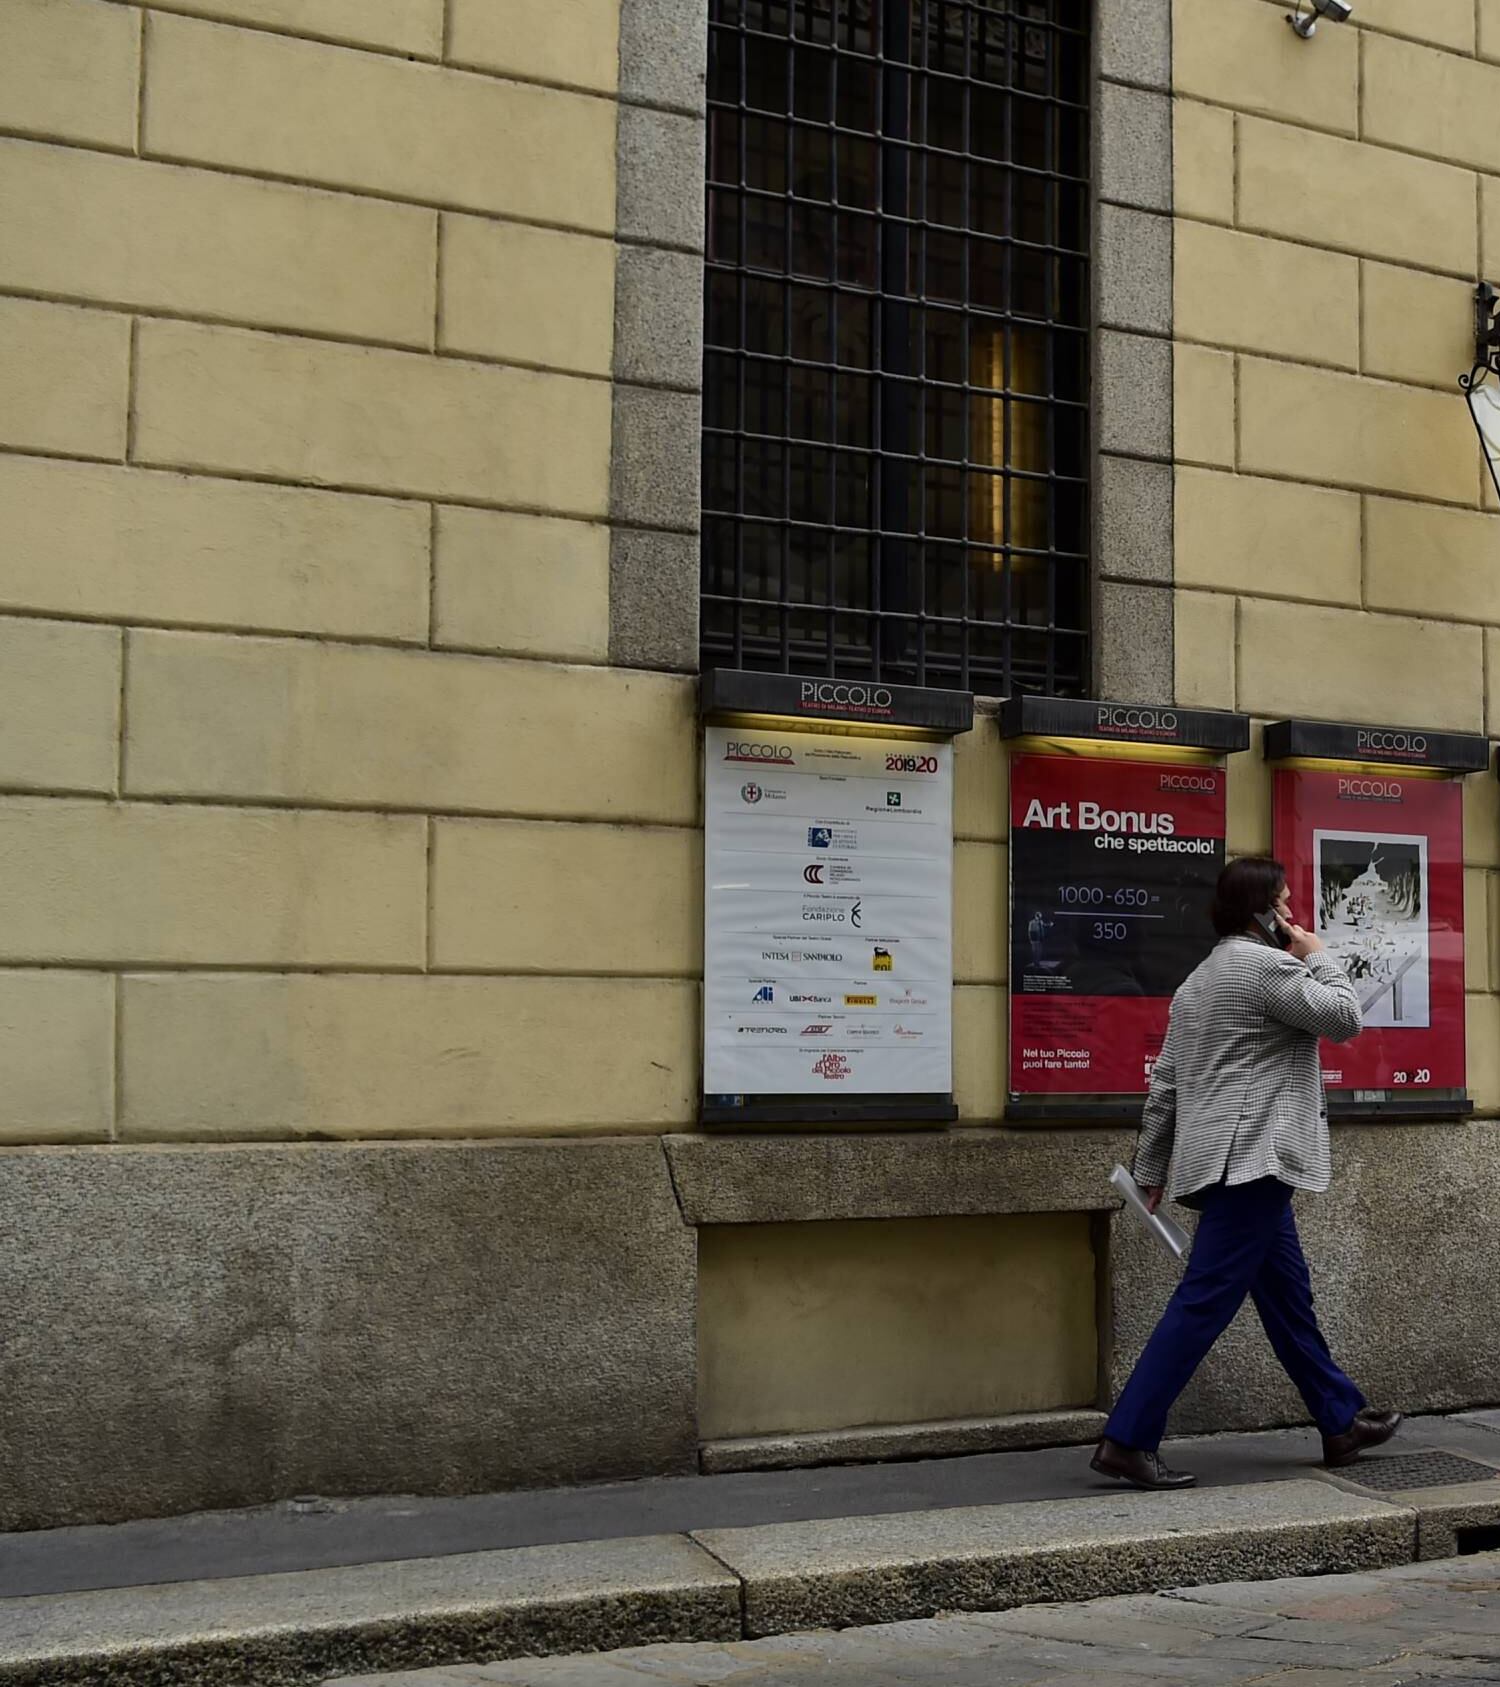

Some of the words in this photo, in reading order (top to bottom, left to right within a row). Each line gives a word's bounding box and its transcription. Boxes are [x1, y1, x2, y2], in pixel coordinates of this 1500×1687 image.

[801, 682, 892, 707] PICCOLO
[1098, 707, 1178, 730] PICCOLO
[1357, 730, 1427, 752] PICCOLO
[726, 742, 793, 759] PICCOLO
[1160, 774, 1216, 790] PICCOLO
[1338, 779, 1402, 798] PICCOLO
[1022, 799, 1070, 830] Art
[1078, 801, 1175, 835] Bonus
[1094, 833, 1125, 850] che
[1128, 836, 1215, 854] spettacolo!
[1058, 886, 1104, 904] 1000
[802, 913, 845, 921] CARIPLO
[1093, 922, 1127, 940] 350
[1023, 1049, 1038, 1058] Nel
[1040, 1050, 1055, 1058] tuo
[1056, 1049, 1090, 1058] Piccolo
[1023, 1061, 1043, 1070] puoi
[1044, 1060, 1062, 1069] fare
[1064, 1060, 1090, 1069] tanto!
